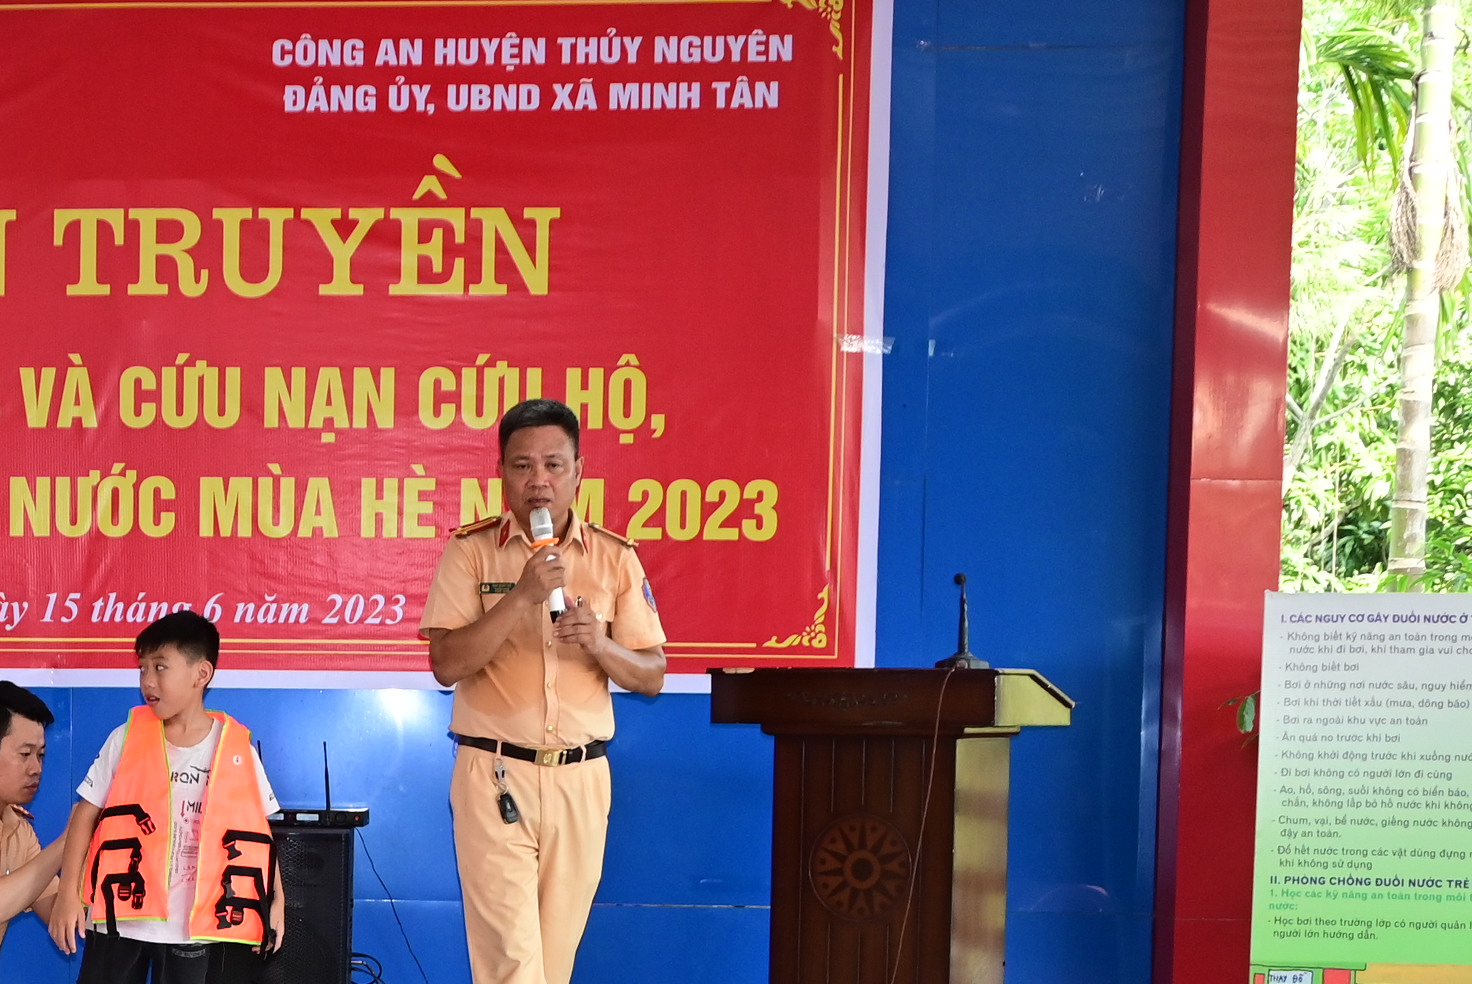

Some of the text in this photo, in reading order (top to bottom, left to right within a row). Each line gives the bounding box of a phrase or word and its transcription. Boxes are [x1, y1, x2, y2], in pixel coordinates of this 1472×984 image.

[272, 28, 793, 71] CÔNG AN HUYỆN THỦY NGUYÊN
[284, 76, 779, 115] ĐẢNG ỦY, UBND XÃ MINH TÂN
[53, 153, 562, 298] TRUYỀN
[19, 353, 97, 429] VÀ
[120, 353, 241, 429] CỨU
[264, 366, 395, 442] NẠN
[565, 353, 666, 444] HỘ,
[9, 462, 175, 538] NƯỚC
[199, 463, 339, 538] MÙA
[360, 464, 436, 539] HÈ
[627, 479, 779, 541] 2023
[41, 592, 79, 623] 15
[203, 592, 224, 623] 6
[234, 593, 309, 624] năm
[324, 593, 407, 625] 2023
